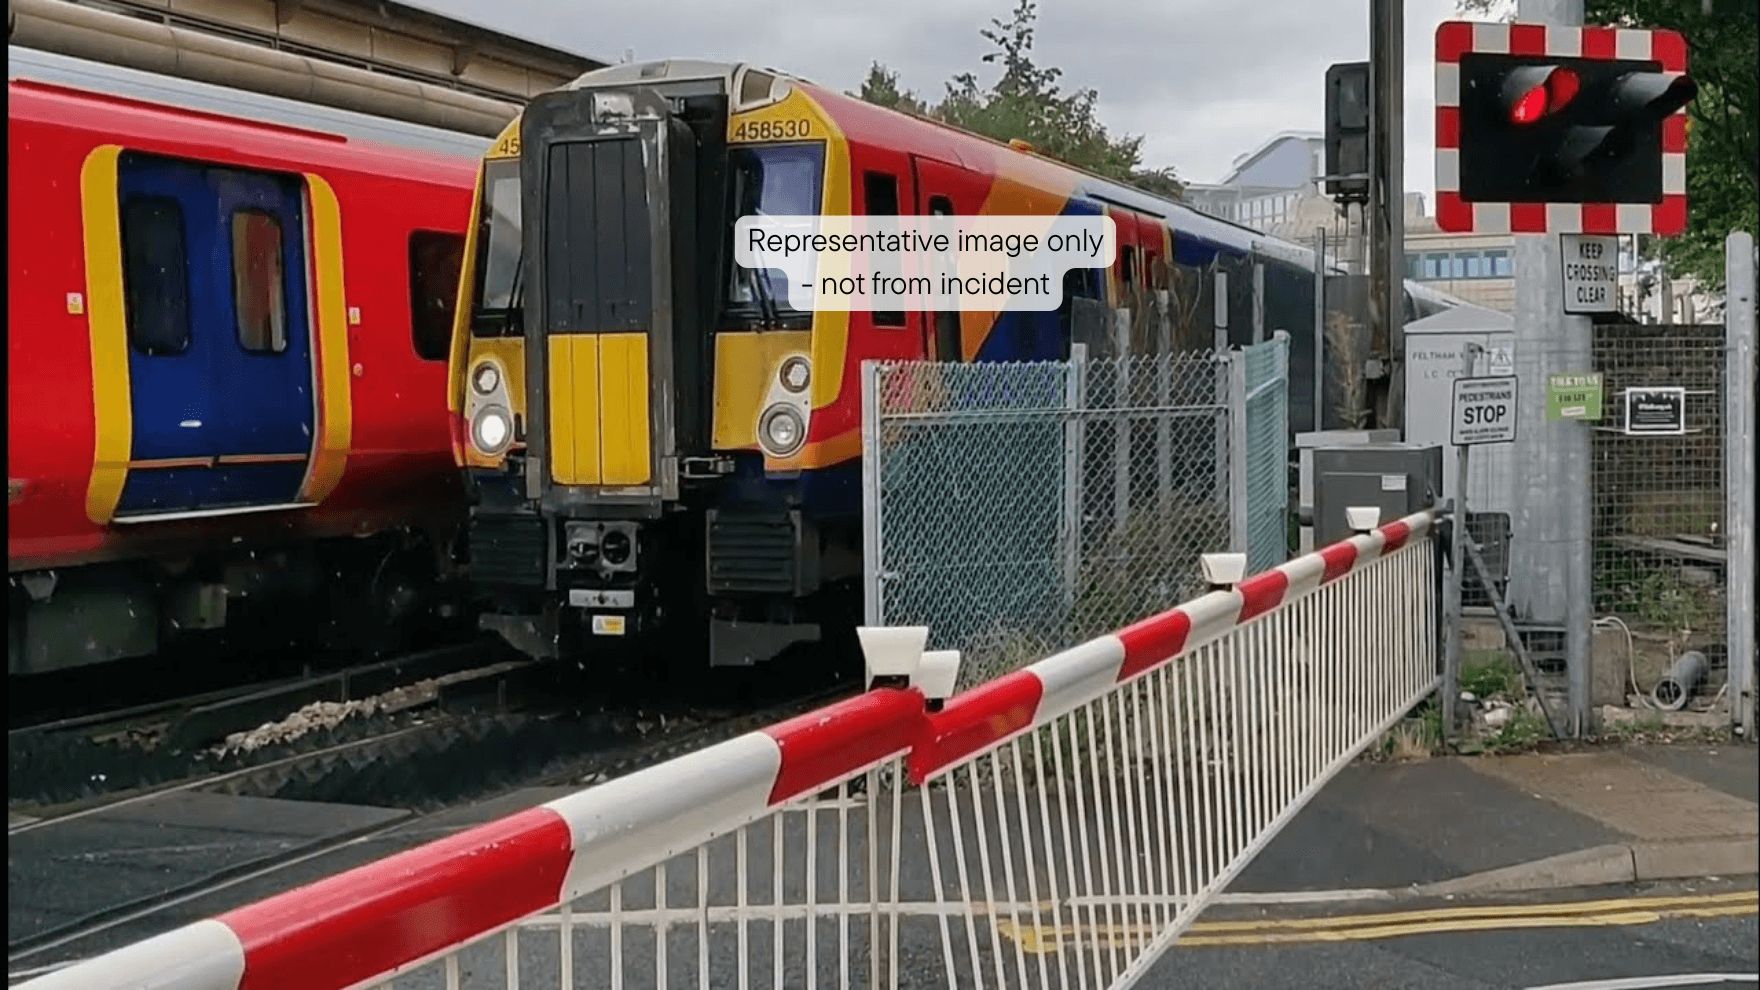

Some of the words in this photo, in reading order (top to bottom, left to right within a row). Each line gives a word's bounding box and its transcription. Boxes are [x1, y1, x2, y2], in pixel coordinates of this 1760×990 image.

[735, 118, 811, 139] 458530
[1580, 243, 1604, 259] KEEP
[1566, 264, 1616, 282] CROSSING
[1576, 286, 1606, 303] CLEAR
[1459, 390, 1512, 402] PEDESTRIANS
[1463, 404, 1507, 425] STOP
